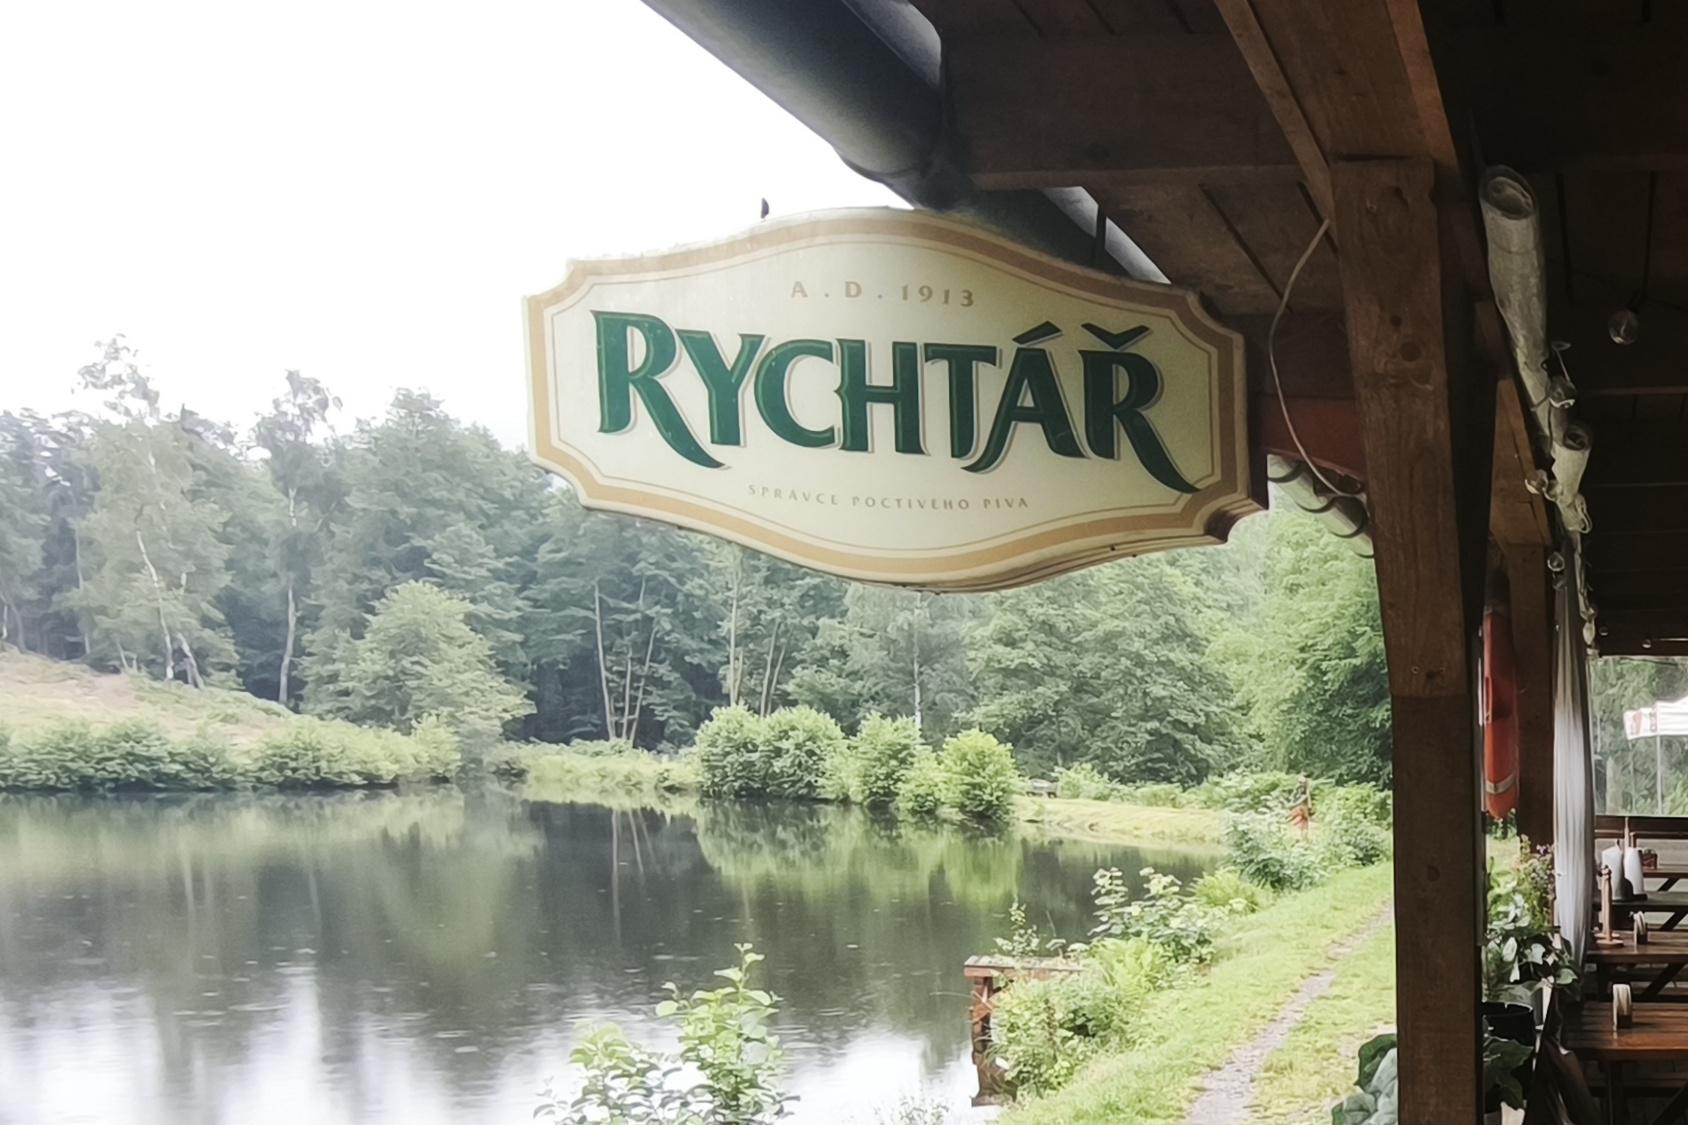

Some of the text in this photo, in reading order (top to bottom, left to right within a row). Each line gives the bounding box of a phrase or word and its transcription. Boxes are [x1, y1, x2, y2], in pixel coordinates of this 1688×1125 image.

[902, 284, 974, 307] 1913
[590, 309, 1200, 494] RYCHTÁŘ
[983, 497, 1029, 510] PIVA
